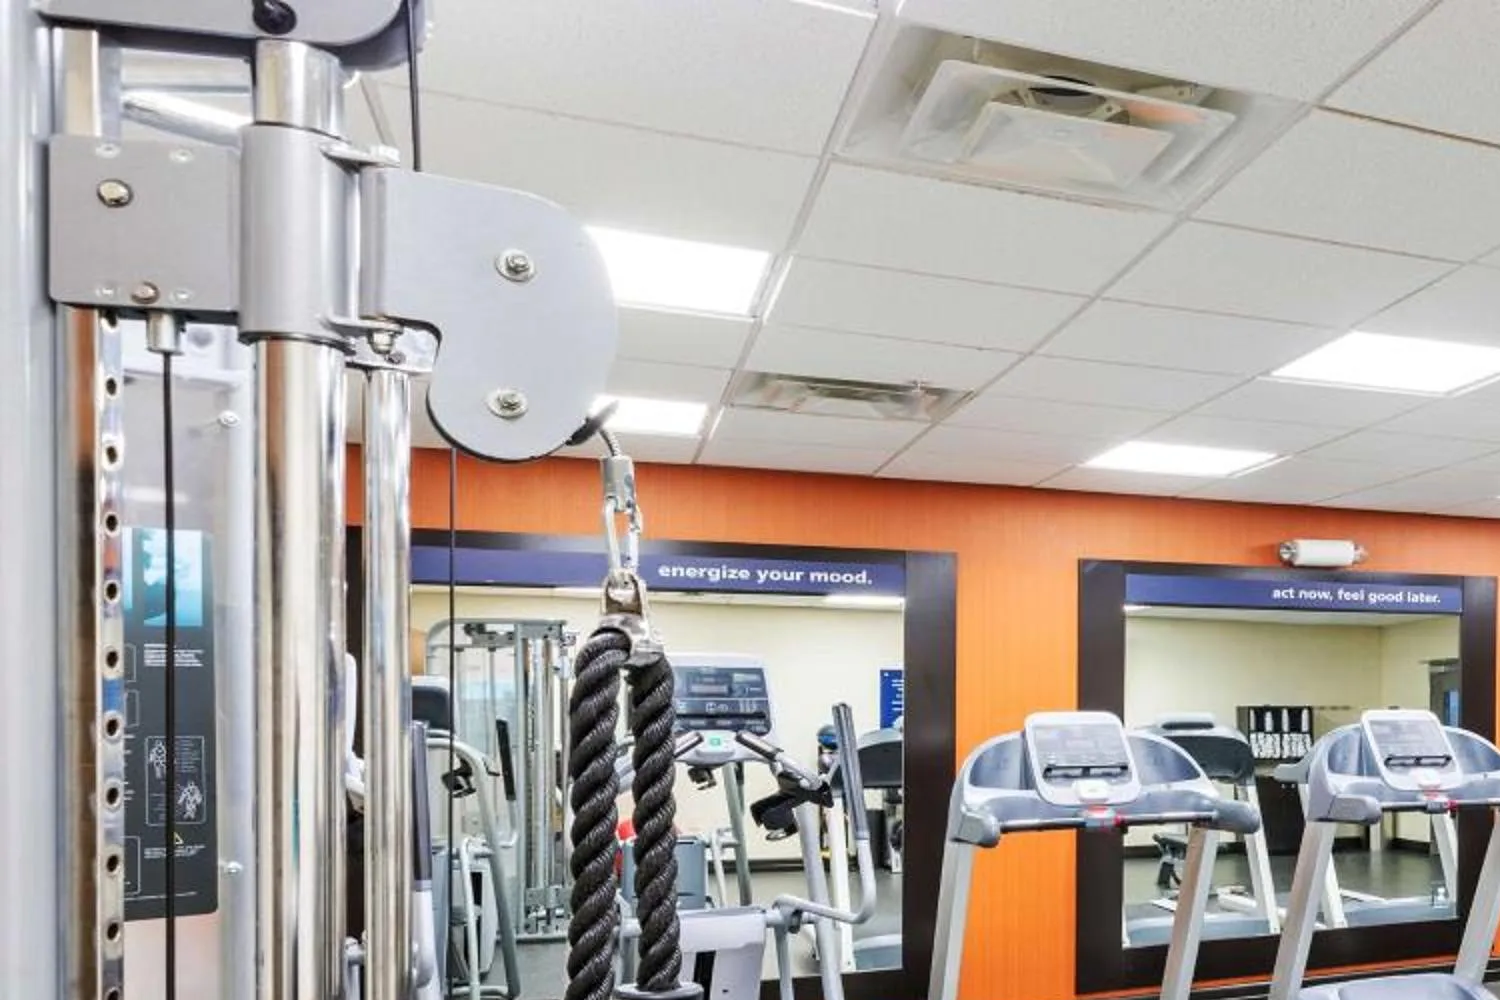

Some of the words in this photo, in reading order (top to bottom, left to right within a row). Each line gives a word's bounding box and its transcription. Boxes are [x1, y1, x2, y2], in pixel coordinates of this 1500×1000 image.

[658, 564, 751, 582] energize
[756, 568, 804, 583] your
[809, 569, 873, 585] mood.
[1272, 587, 1295, 600] act
[1299, 589, 1333, 602] now,
[1337, 588, 1364, 601] feel
[1368, 589, 1402, 604] good
[1407, 591, 1441, 603] later.
